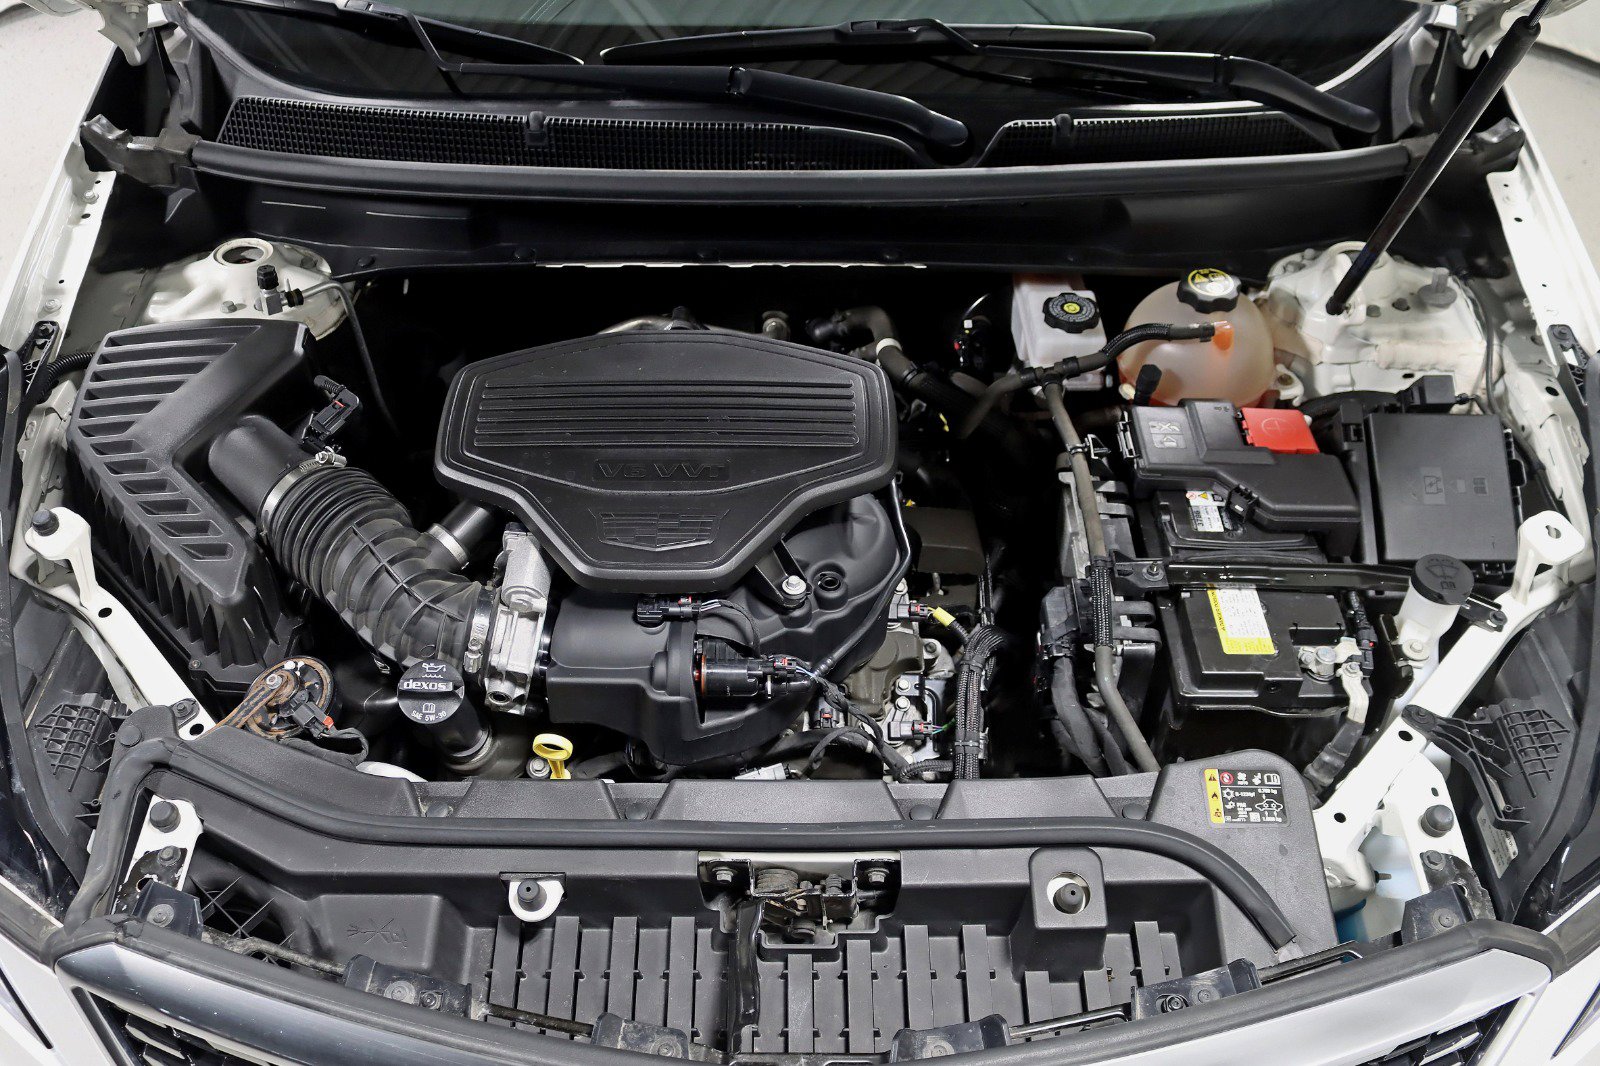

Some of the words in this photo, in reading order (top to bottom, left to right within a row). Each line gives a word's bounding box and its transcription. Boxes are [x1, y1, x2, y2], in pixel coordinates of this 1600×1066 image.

[598, 462, 647, 478] V6
[653, 462, 726, 478] VVT
[403, 679, 447, 691] dexos
[411, 709, 424, 720] SAE
[424, 710, 447, 722] 5W-30
